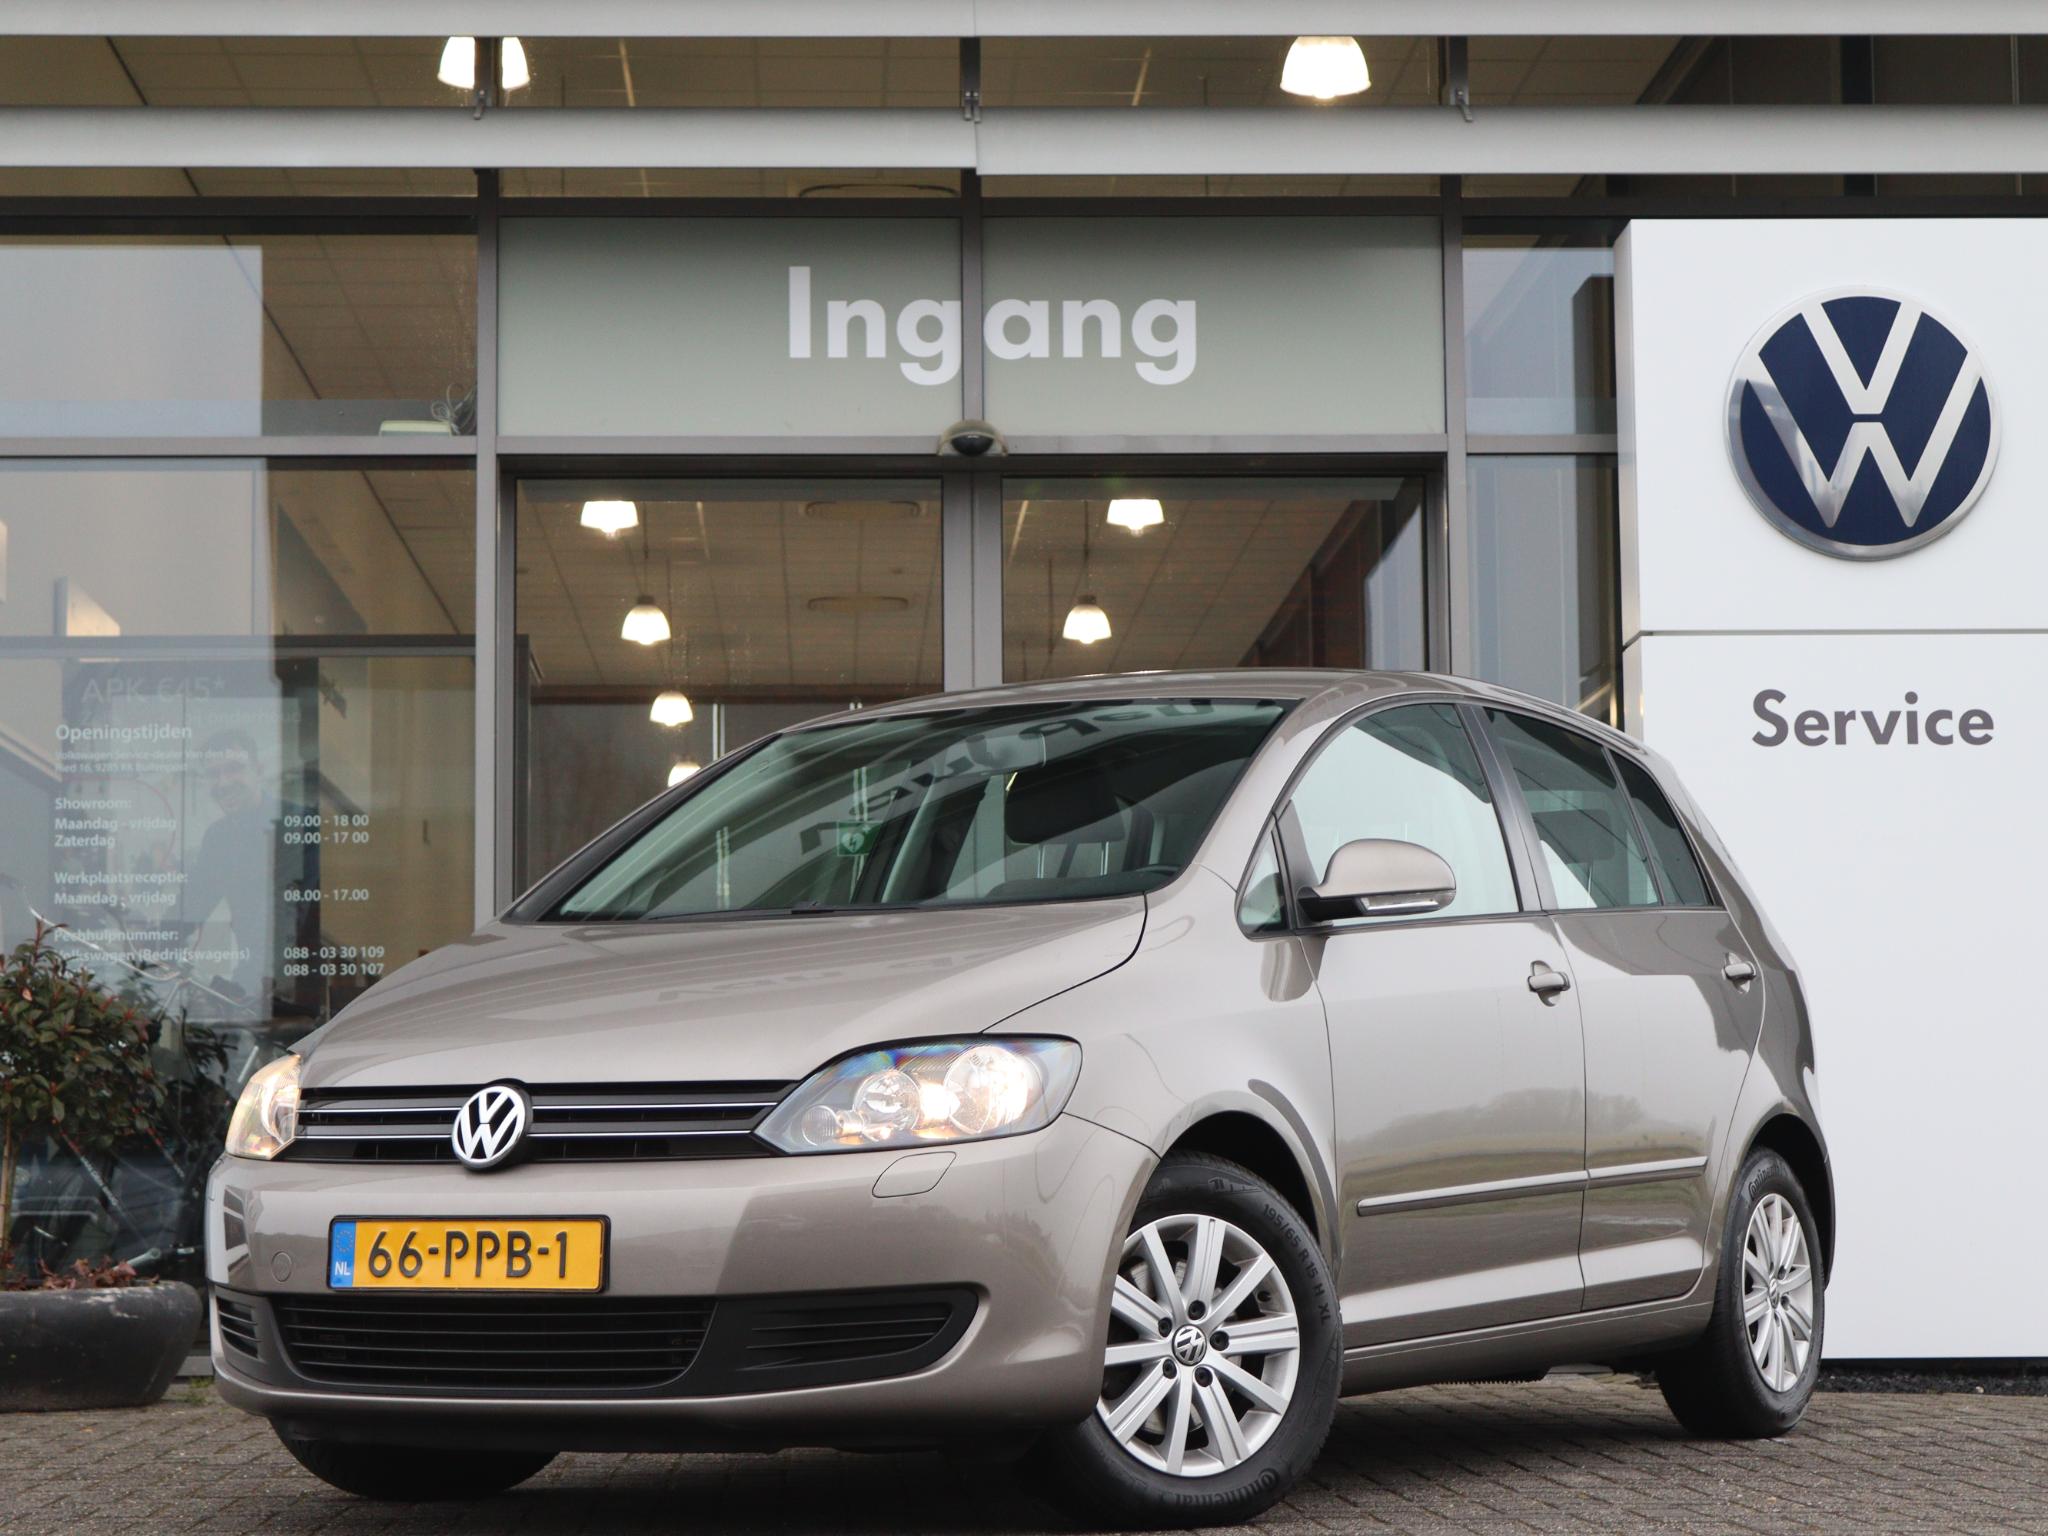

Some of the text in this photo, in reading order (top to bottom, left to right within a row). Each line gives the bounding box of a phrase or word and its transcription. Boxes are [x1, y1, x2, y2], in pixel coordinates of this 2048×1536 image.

[789, 266, 1197, 385] Ingang
[81, 677, 146, 704] APK
[1752, 688, 1994, 747] Service
[55, 723, 192, 743] Openingstijden
[55, 797, 132, 810] Showroom:
[54, 817, 118, 832] Maandag
[129, 817, 177, 832] vrijdag
[284, 815, 321, 827] 09.00
[333, 815, 349, 827] 18
[352, 814, 369, 827] 00
[54, 833, 116, 848] Zaterdag
[284, 832, 321, 844] 09.00
[333, 832, 349, 844] 17
[352, 831, 369, 844] 00
[54, 871, 188, 886] Werkplaatsreceptie:
[54, 891, 118, 906] Maandag
[129, 890, 177, 906] vrijdag
[284, 889, 321, 902] 08.00
[333, 888, 369, 901] 17.00
[138, 947, 250, 964] (Bedrijfswagens)
[283, 946, 310, 959] 088
[320, 946, 337, 959] 03
[339, 946, 357, 959] 30
[360, 946, 385, 958] 109
[283, 963, 310, 976] 088
[320, 963, 337, 975] 03
[339, 963, 357, 975] 30
[361, 963, 385, 975] 107
[1263, 1203, 1302, 1248] 195/65
[368, 1230, 568, 1279] 66-PPB-1
[334, 1261, 351, 1276] NL
[1313, 1283, 1325, 1297] H
[1317, 1303, 1332, 1325] XL
